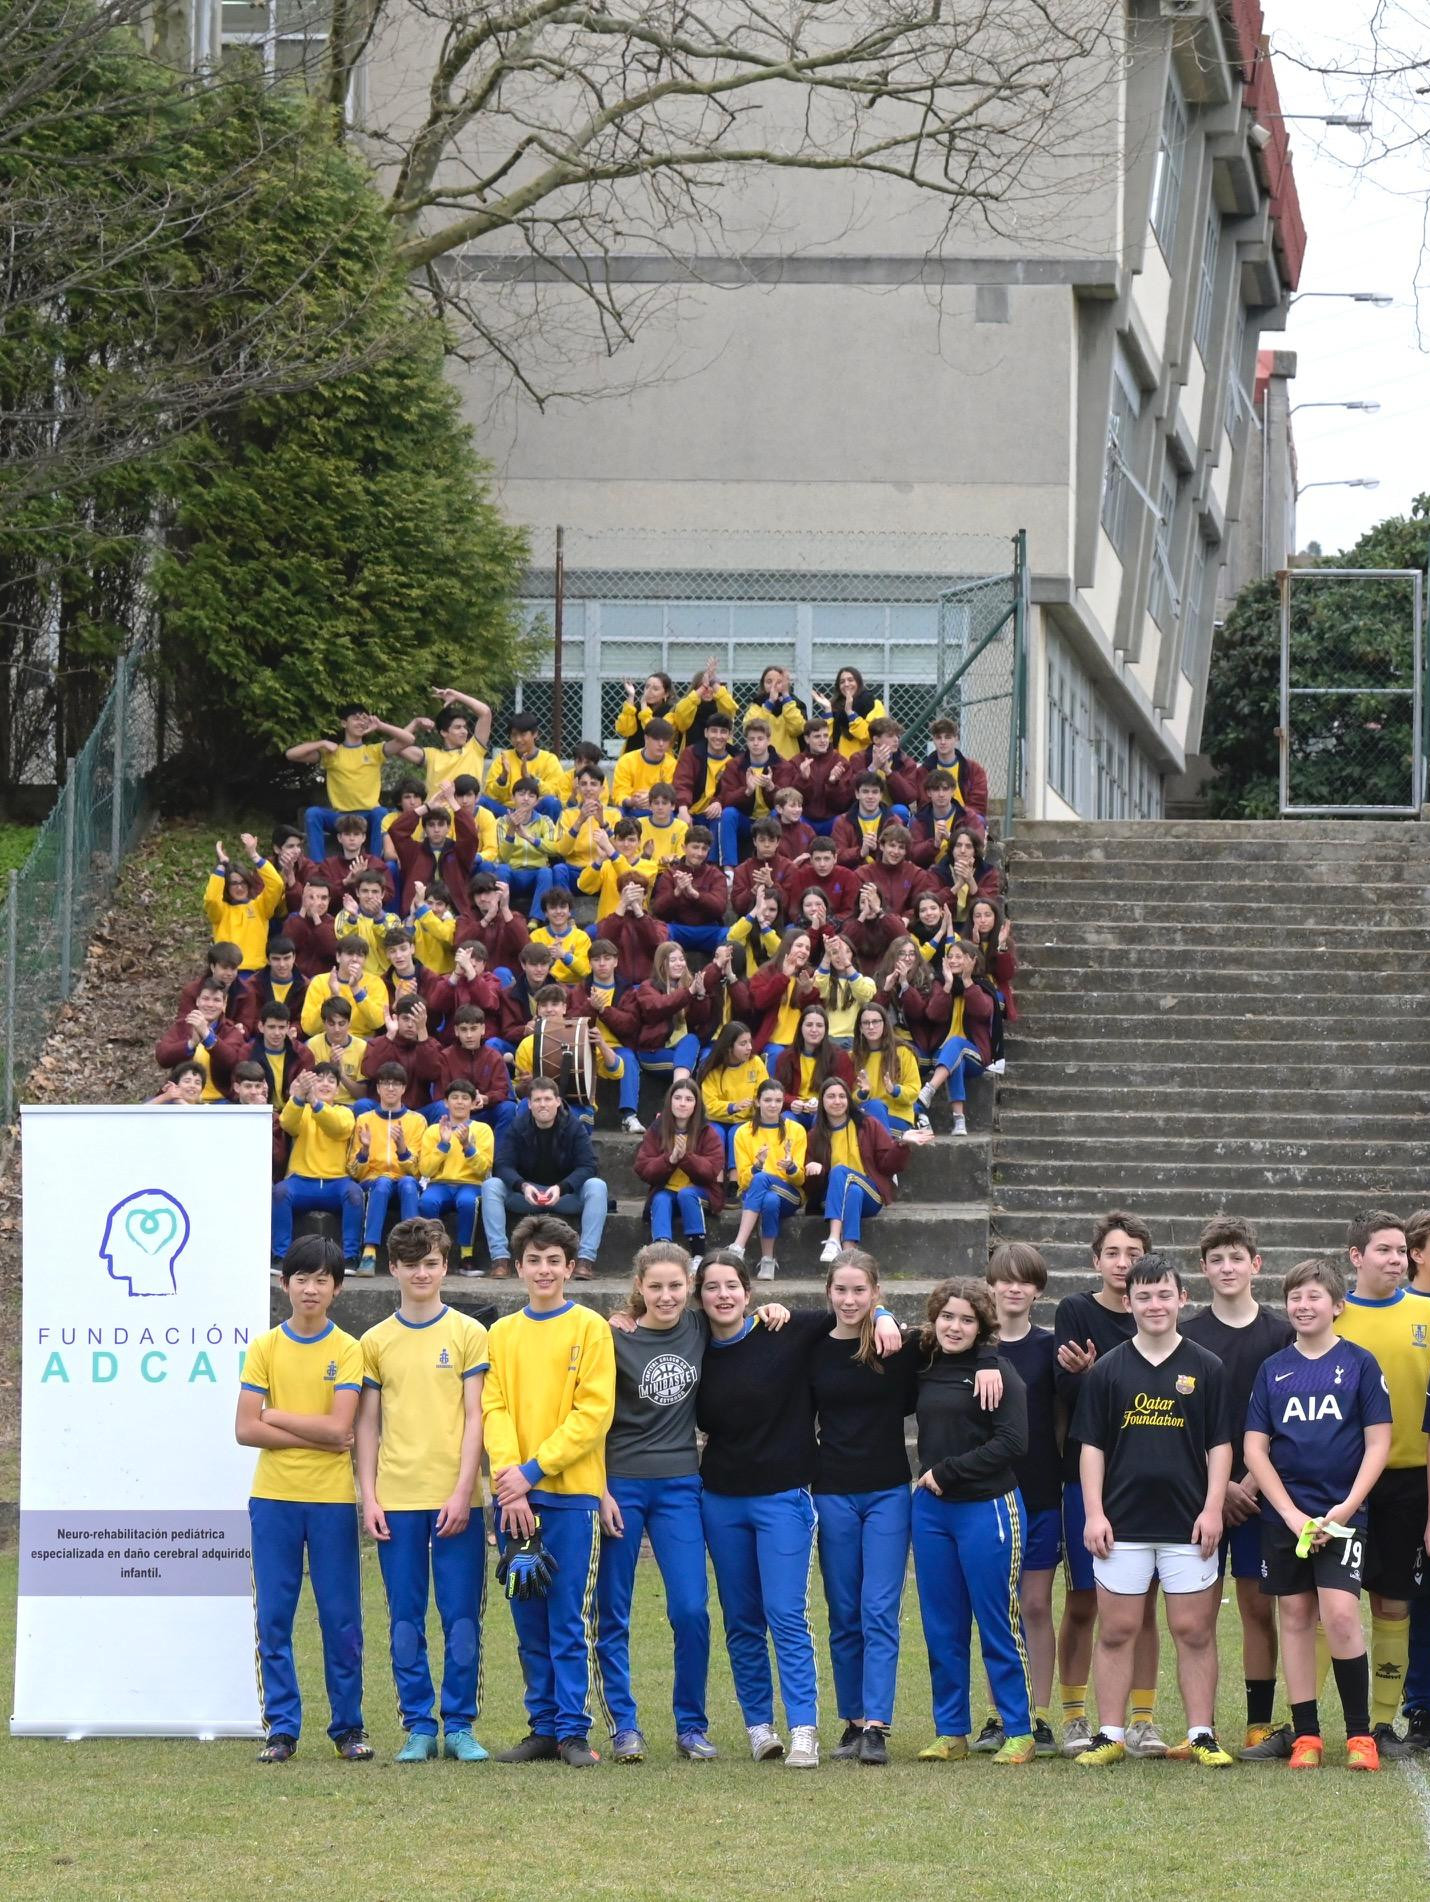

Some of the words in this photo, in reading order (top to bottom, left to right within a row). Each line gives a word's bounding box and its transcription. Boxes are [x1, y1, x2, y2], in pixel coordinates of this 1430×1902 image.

[38, 1323, 249, 1345] FUNDACIÓN
[641, 1369, 696, 1397] MINIBASKET
[1134, 1392, 1175, 1414] Qatar
[1282, 1394, 1343, 1423] AIA
[1120, 1411, 1185, 1429] Foundation
[57, 1528, 167, 1540] Neuro-rehabilitación
[171, 1528, 225, 1541] pediátrica
[31, 1548, 104, 1561] especializada
[107, 1550, 121, 1558] en
[124, 1548, 150, 1558] daño
[153, 1548, 198, 1558] cerebral
[202, 1548, 251, 1561] adquirido
[1340, 1538, 1362, 1568] 19
[120, 1567, 161, 1578] infantil.
